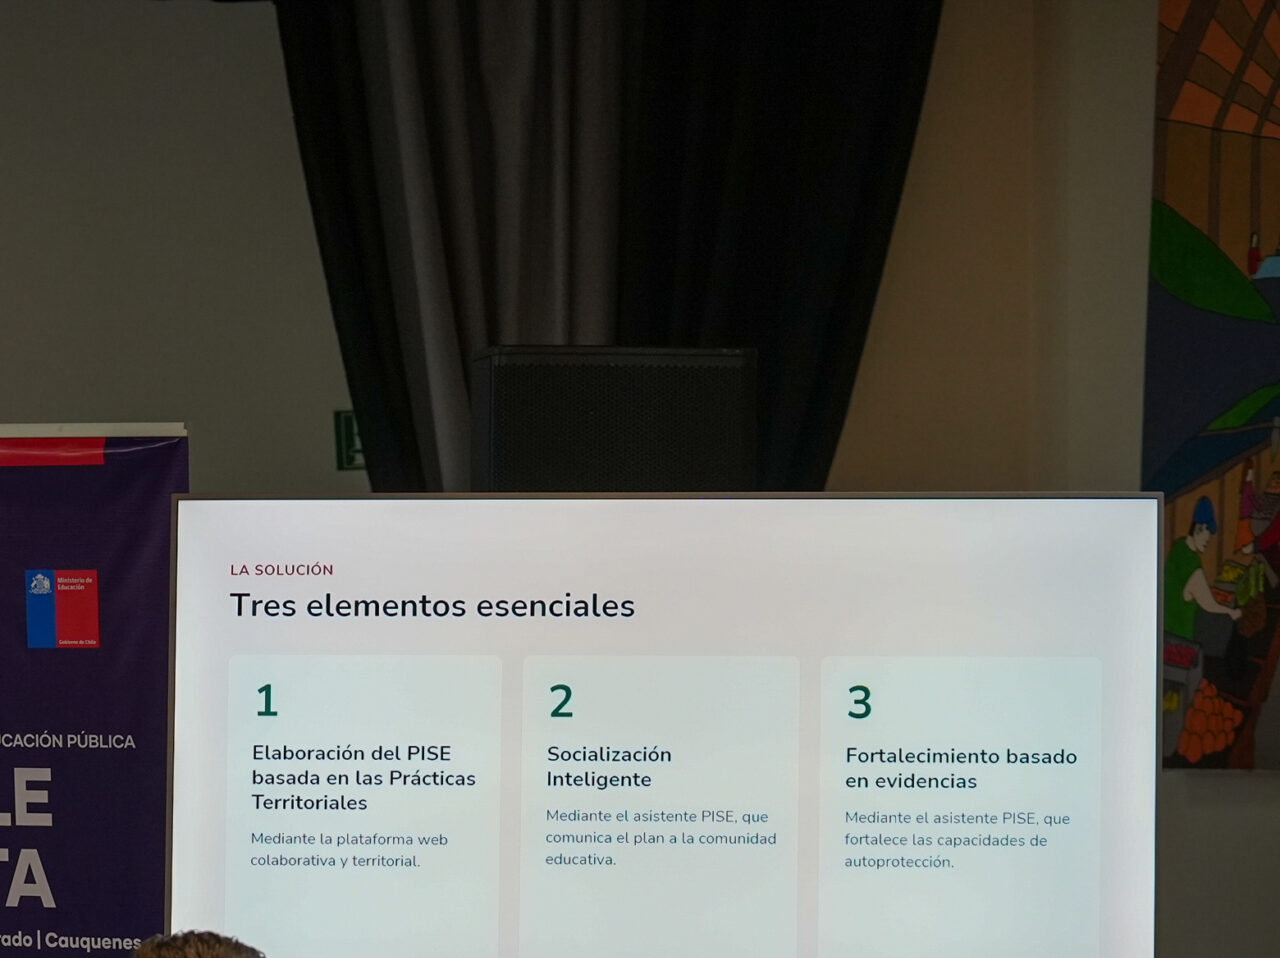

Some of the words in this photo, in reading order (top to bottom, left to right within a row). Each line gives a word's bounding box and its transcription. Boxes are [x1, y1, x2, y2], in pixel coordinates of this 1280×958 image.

[231, 565, 249, 575] LA
[255, 562, 332, 575] SOLUCIÓN
[230, 593, 296, 616] Tres
[307, 593, 465, 617] elementos
[477, 593, 634, 617] esenciales
[258, 684, 277, 716] 1
[550, 684, 573, 717] 2
[848, 685, 871, 719] 3
[67, 731, 135, 748] PÚBLICA
[254, 744, 364, 760] Elaboración
[372, 746, 401, 760] del
[408, 746, 450, 760] PISE
[548, 746, 671, 762] Socialización
[847, 748, 999, 763] Fortalecimiento
[1007, 749, 1077, 764] basado
[253, 770, 319, 785] basada
[327, 774, 348, 785] en
[356, 771, 382, 785] las
[390, 770, 475, 785] Prácticas
[548, 771, 651, 790] Inteligente
[846, 777, 868, 788] en
[876, 773, 976, 788] evidencias
[252, 794, 367, 810] Territoriales
[547, 810, 611, 821] Mediante
[616, 810, 628, 822] el
[634, 810, 697, 822] asistente
[702, 810, 737, 823] PISE,
[742, 814, 768, 824] que
[846, 812, 911, 823] Mediante
[916, 812, 928, 823] el
[934, 812, 997, 824] asistente
[1003, 812, 1038, 825] PISE,
[1044, 816, 1070, 826] que
[252, 833, 315, 844] Mediante
[321, 833, 332, 844] la
[337, 833, 413, 847] plataforma
[418, 834, 448, 845] web
[546, 832, 612, 843] comunica
[617, 832, 629, 843] el
[634, 832, 664, 845] plan
[669, 835, 676, 844] a
[682, 832, 694, 844] la
[699, 833, 776, 844] comunidad
[845, 833, 907, 845] fortalece
[913, 834, 932, 845] las
[938, 834, 1025, 848] capacidades
[1030, 835, 1047, 846] de
[251, 855, 335, 866] colaborativa
[340, 858, 348, 868] y
[352, 855, 420, 867] territorial.
[546, 853, 616, 865] educativa.
[845, 855, 954, 869] autoprotección.
[45, 931, 142, 952] Cauquenes
